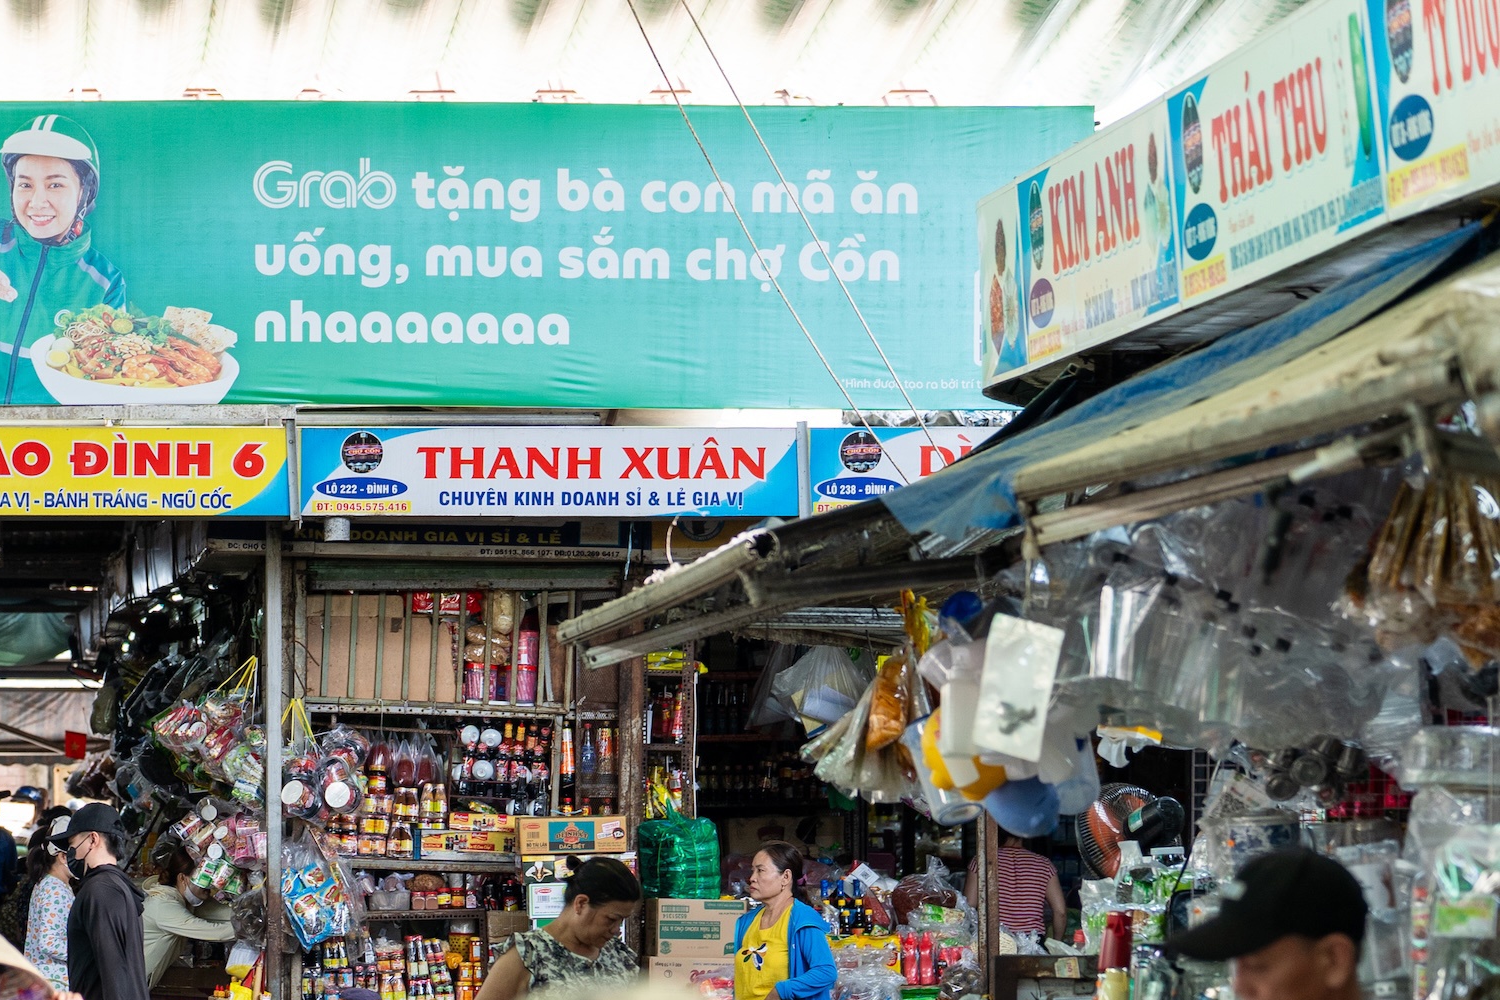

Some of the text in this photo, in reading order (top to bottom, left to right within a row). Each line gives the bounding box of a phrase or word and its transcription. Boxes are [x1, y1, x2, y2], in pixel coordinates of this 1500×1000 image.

[1212, 71, 1272, 204] THÁI
[1274, 57, 1328, 172] THU
[252, 157, 918, 222] Grab tặng bà con mã ăn
[1049, 170, 1091, 276] KIM
[1095, 144, 1140, 264] ANH
[254, 226, 900, 292] uống, mua sắm chợ Cồn
[253, 300, 570, 345] nhaaaaaaa
[904, 380, 923, 390] tạo
[941, 379, 958, 389] bởi
[961, 379, 975, 389] trí
[69, 433, 211, 477] ĐÌNH
[232, 442, 266, 478] 6
[417, 436, 766, 480] THANH XUÂN
[14, 492, 29, 511] VỊ
[44, 488, 88, 508] BÁNH
[93, 488, 147, 508] TRÁNG
[162, 489, 196, 508] NGŨ
[200, 487, 232, 508] CỐC
[326, 481, 398, 494] LÔ 222 ĐÌNH 6
[439, 487, 743, 509] CHUYÊN KINH DOANH SỈ & LẺ GIA VỊ
[826, 482, 887, 495] LÔ 238 ĐÌNH
[316, 502, 408, 511] ĐT: 0945.575.416
[351, 530, 419, 542] DOANH
[424, 530, 458, 543] GIA
[465, 531, 484, 545] VỊ
[517, 531, 530, 543] &
